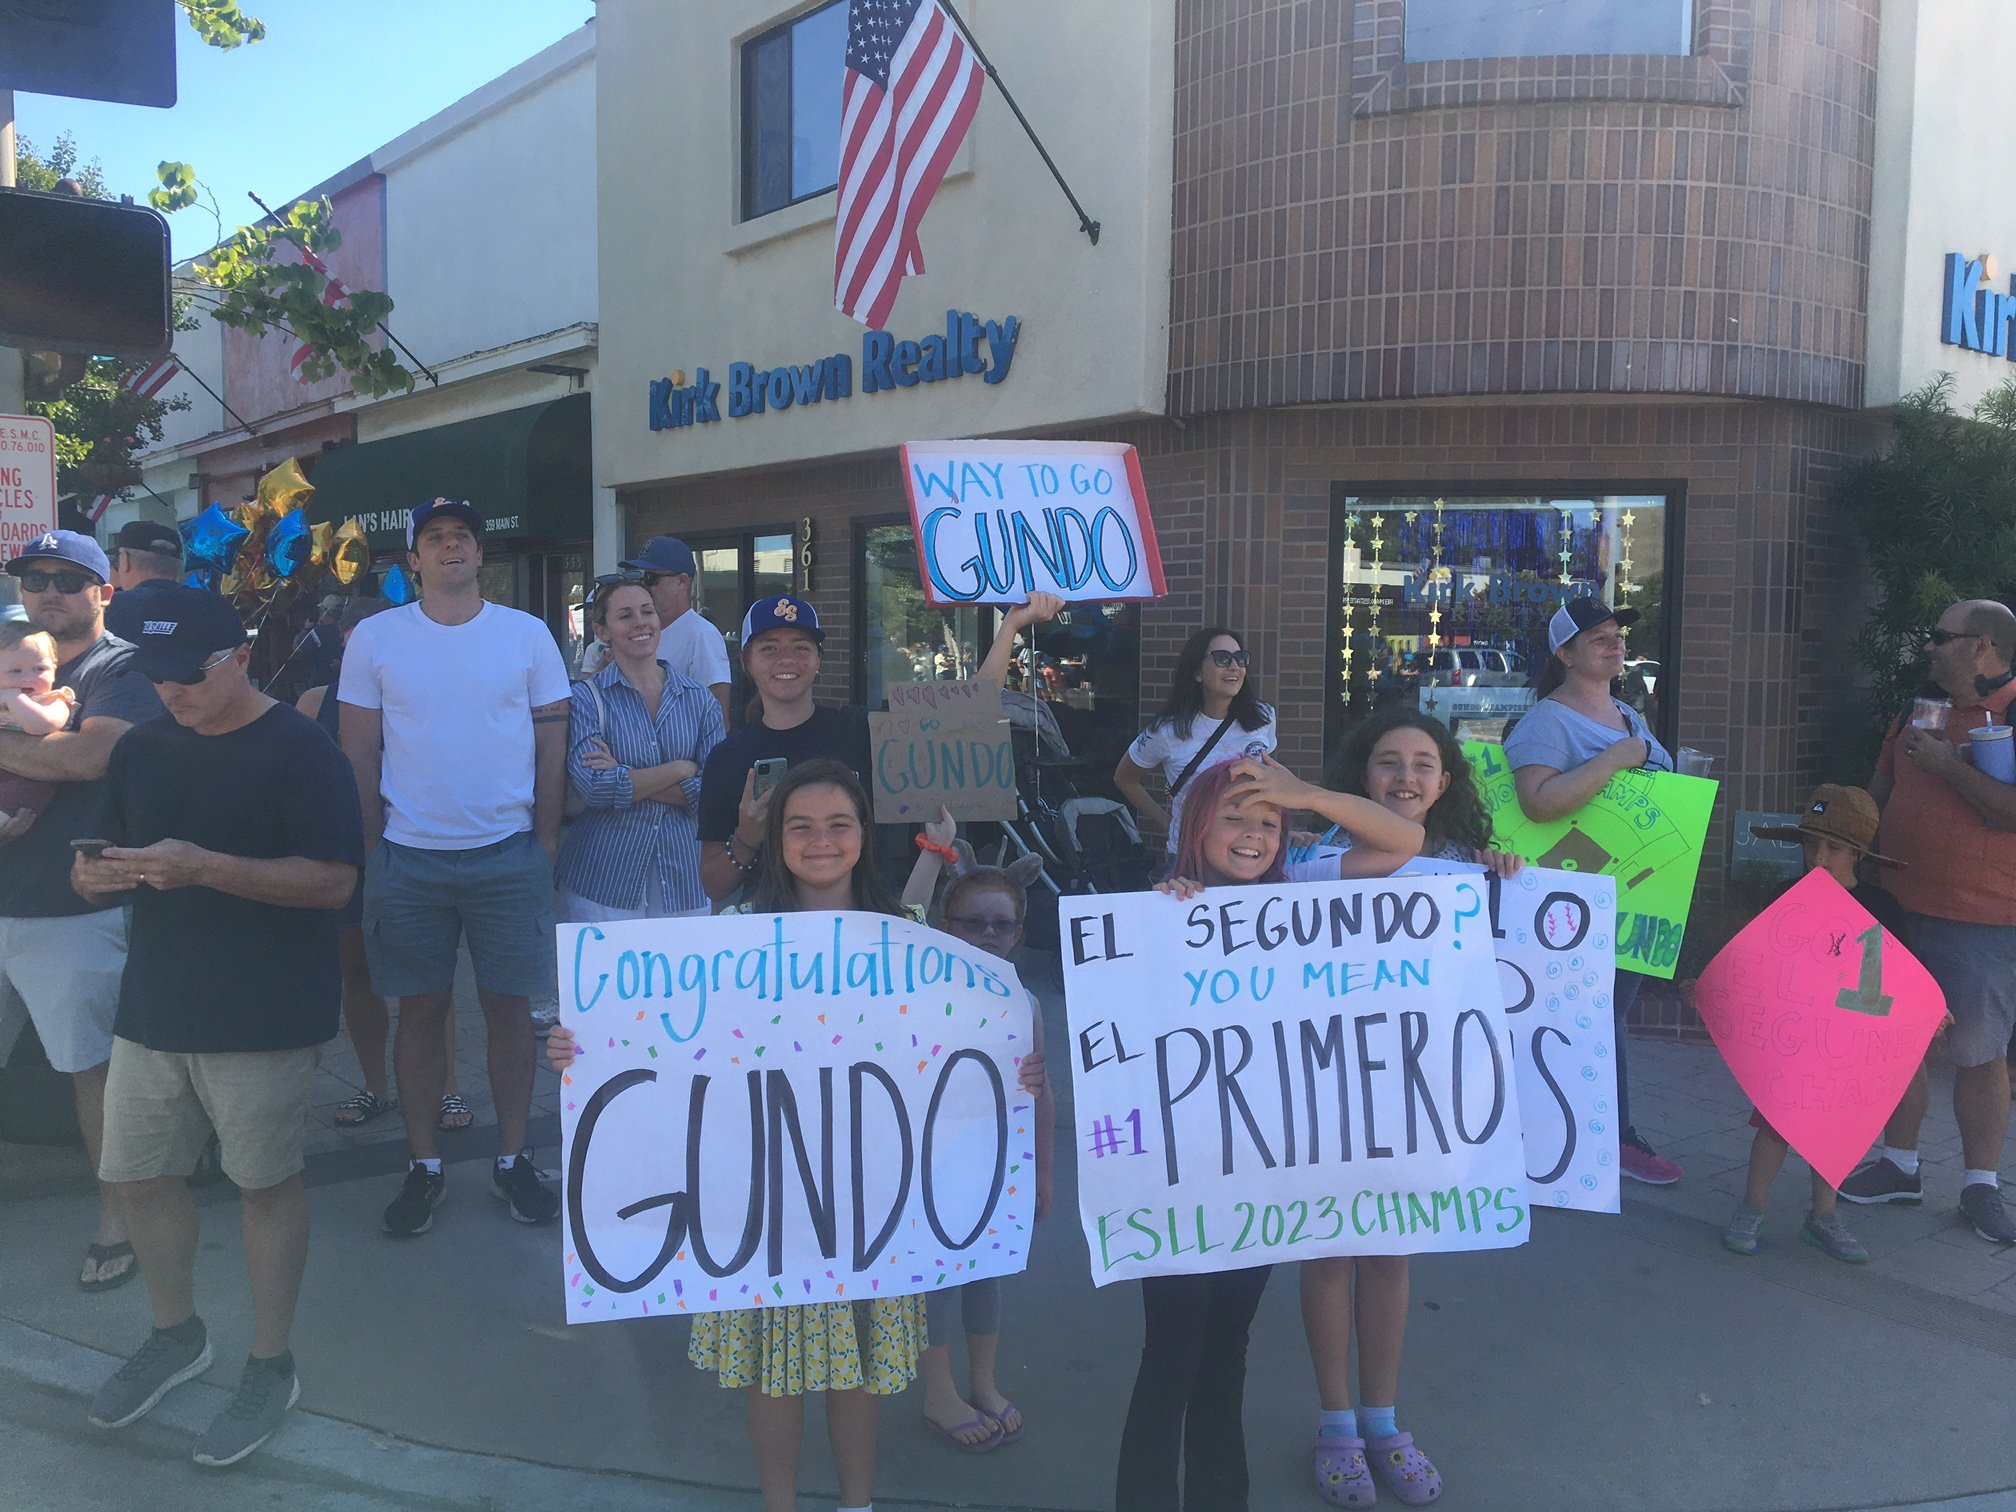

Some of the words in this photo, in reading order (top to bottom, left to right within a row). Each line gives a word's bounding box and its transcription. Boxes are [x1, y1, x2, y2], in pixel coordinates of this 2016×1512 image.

[649, 367, 721, 432] Kirk
[728, 360, 852, 418] Brown
[862, 309, 1022, 393] Realty
[913, 460, 1005, 502] WAY
[1018, 463, 1060, 498] TO
[1070, 463, 1113, 495] GO
[344, 512, 378, 533] N'S
[921, 506, 1138, 601] GUNDO
[773, 598, 797, 622] ES
[1404, 572, 1475, 603] Kirk
[1489, 574, 1600, 603] Brown
[1451, 605, 1551, 623] REALTY
[919, 717, 940, 732] GO
[877, 738, 1014, 795] GUNDO
[1597, 778, 1661, 831] AMPS
[1069, 912, 1134, 967] EL
[573, 916, 1012, 1044] Congratulations
[1182, 968, 1275, 1007] YOU
[1303, 958, 1431, 998] MEAN
[1079, 1020, 1144, 1073] EL
[1085, 1108, 1150, 1159] #1
[567, 1048, 1009, 1294] GUNDO
[1096, 1204, 1223, 1273] ESLL
[1229, 1196, 1344, 1255] 2023
[1351, 1185, 1525, 1236] CHAMPS
